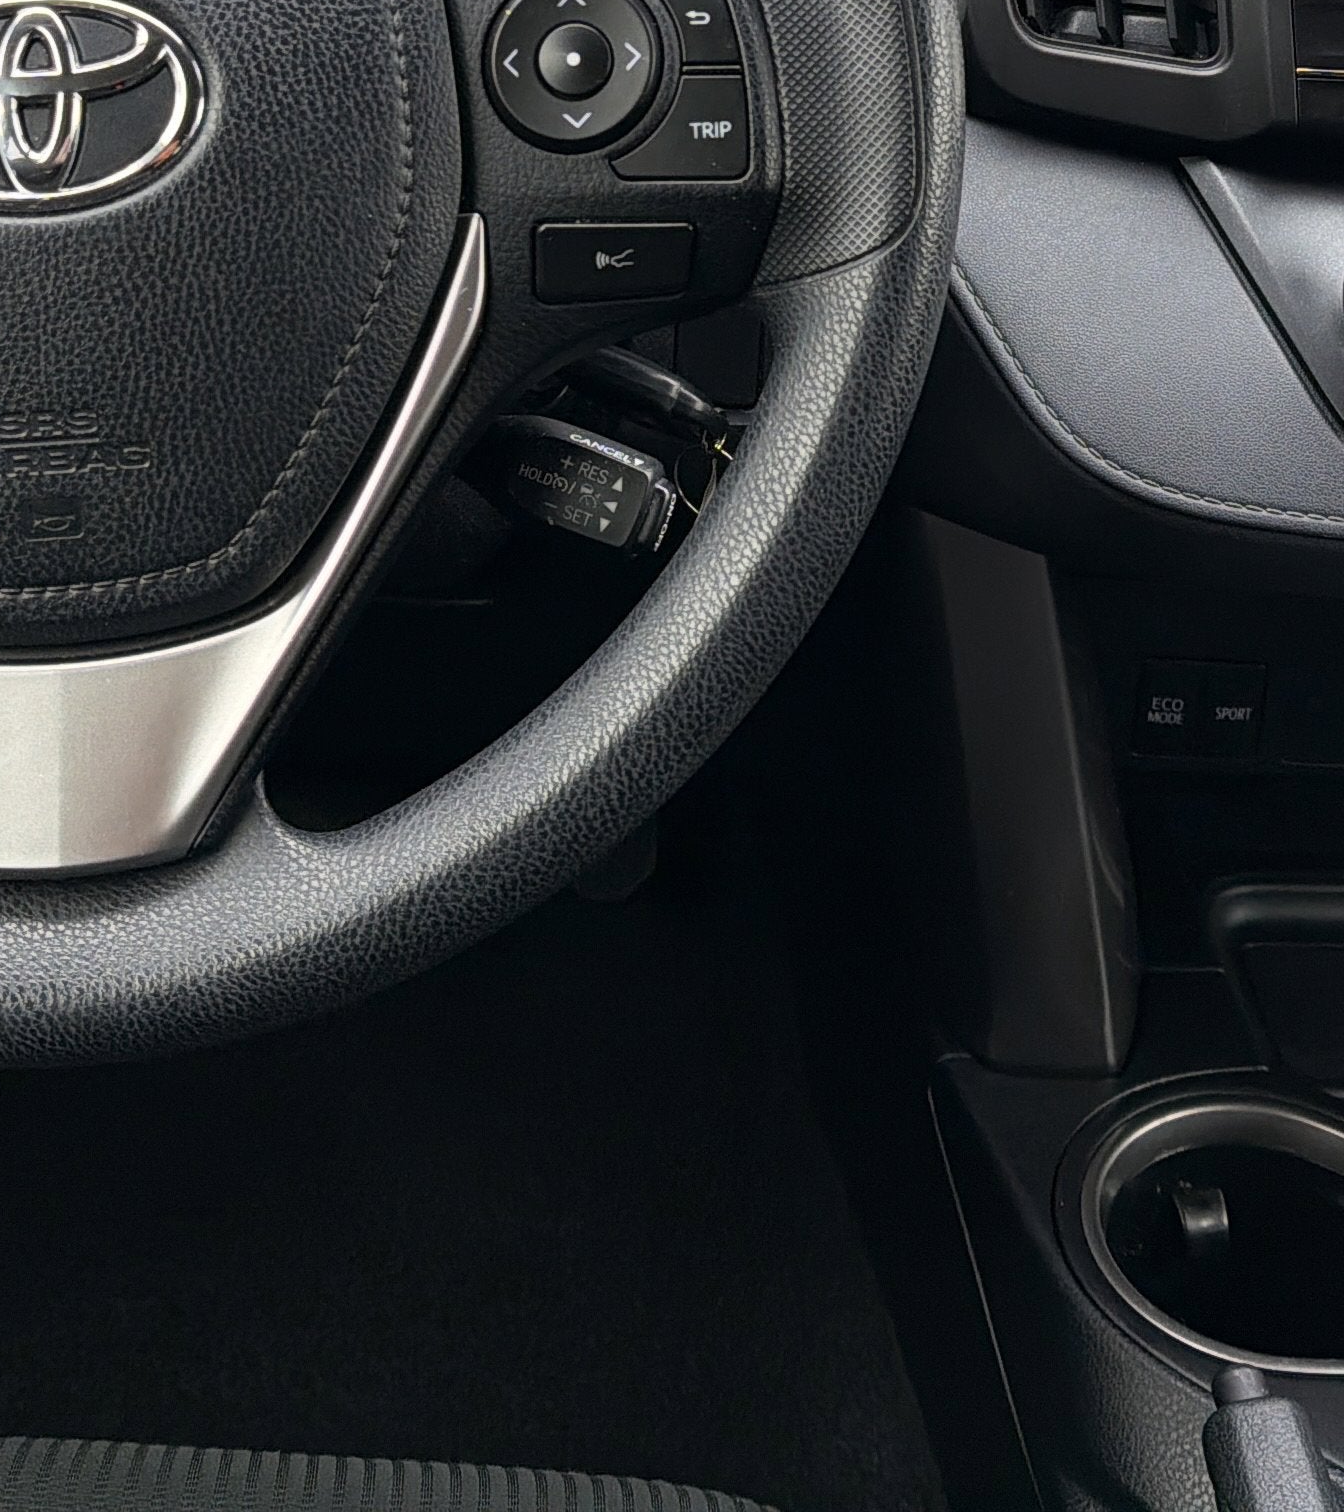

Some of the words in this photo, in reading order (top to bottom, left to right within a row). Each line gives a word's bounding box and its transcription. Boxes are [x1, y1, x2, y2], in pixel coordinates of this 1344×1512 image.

[689, 121, 732, 140] TRIP
[569, 434, 633, 464] CANCEL
[518, 464, 553, 486] HOLD
[578, 461, 609, 485] RES
[562, 505, 593, 527] SET
[1151, 697, 1185, 711] ECO
[1215, 706, 1253, 721] SPORT
[1147, 711, 1184, 726] MODE
